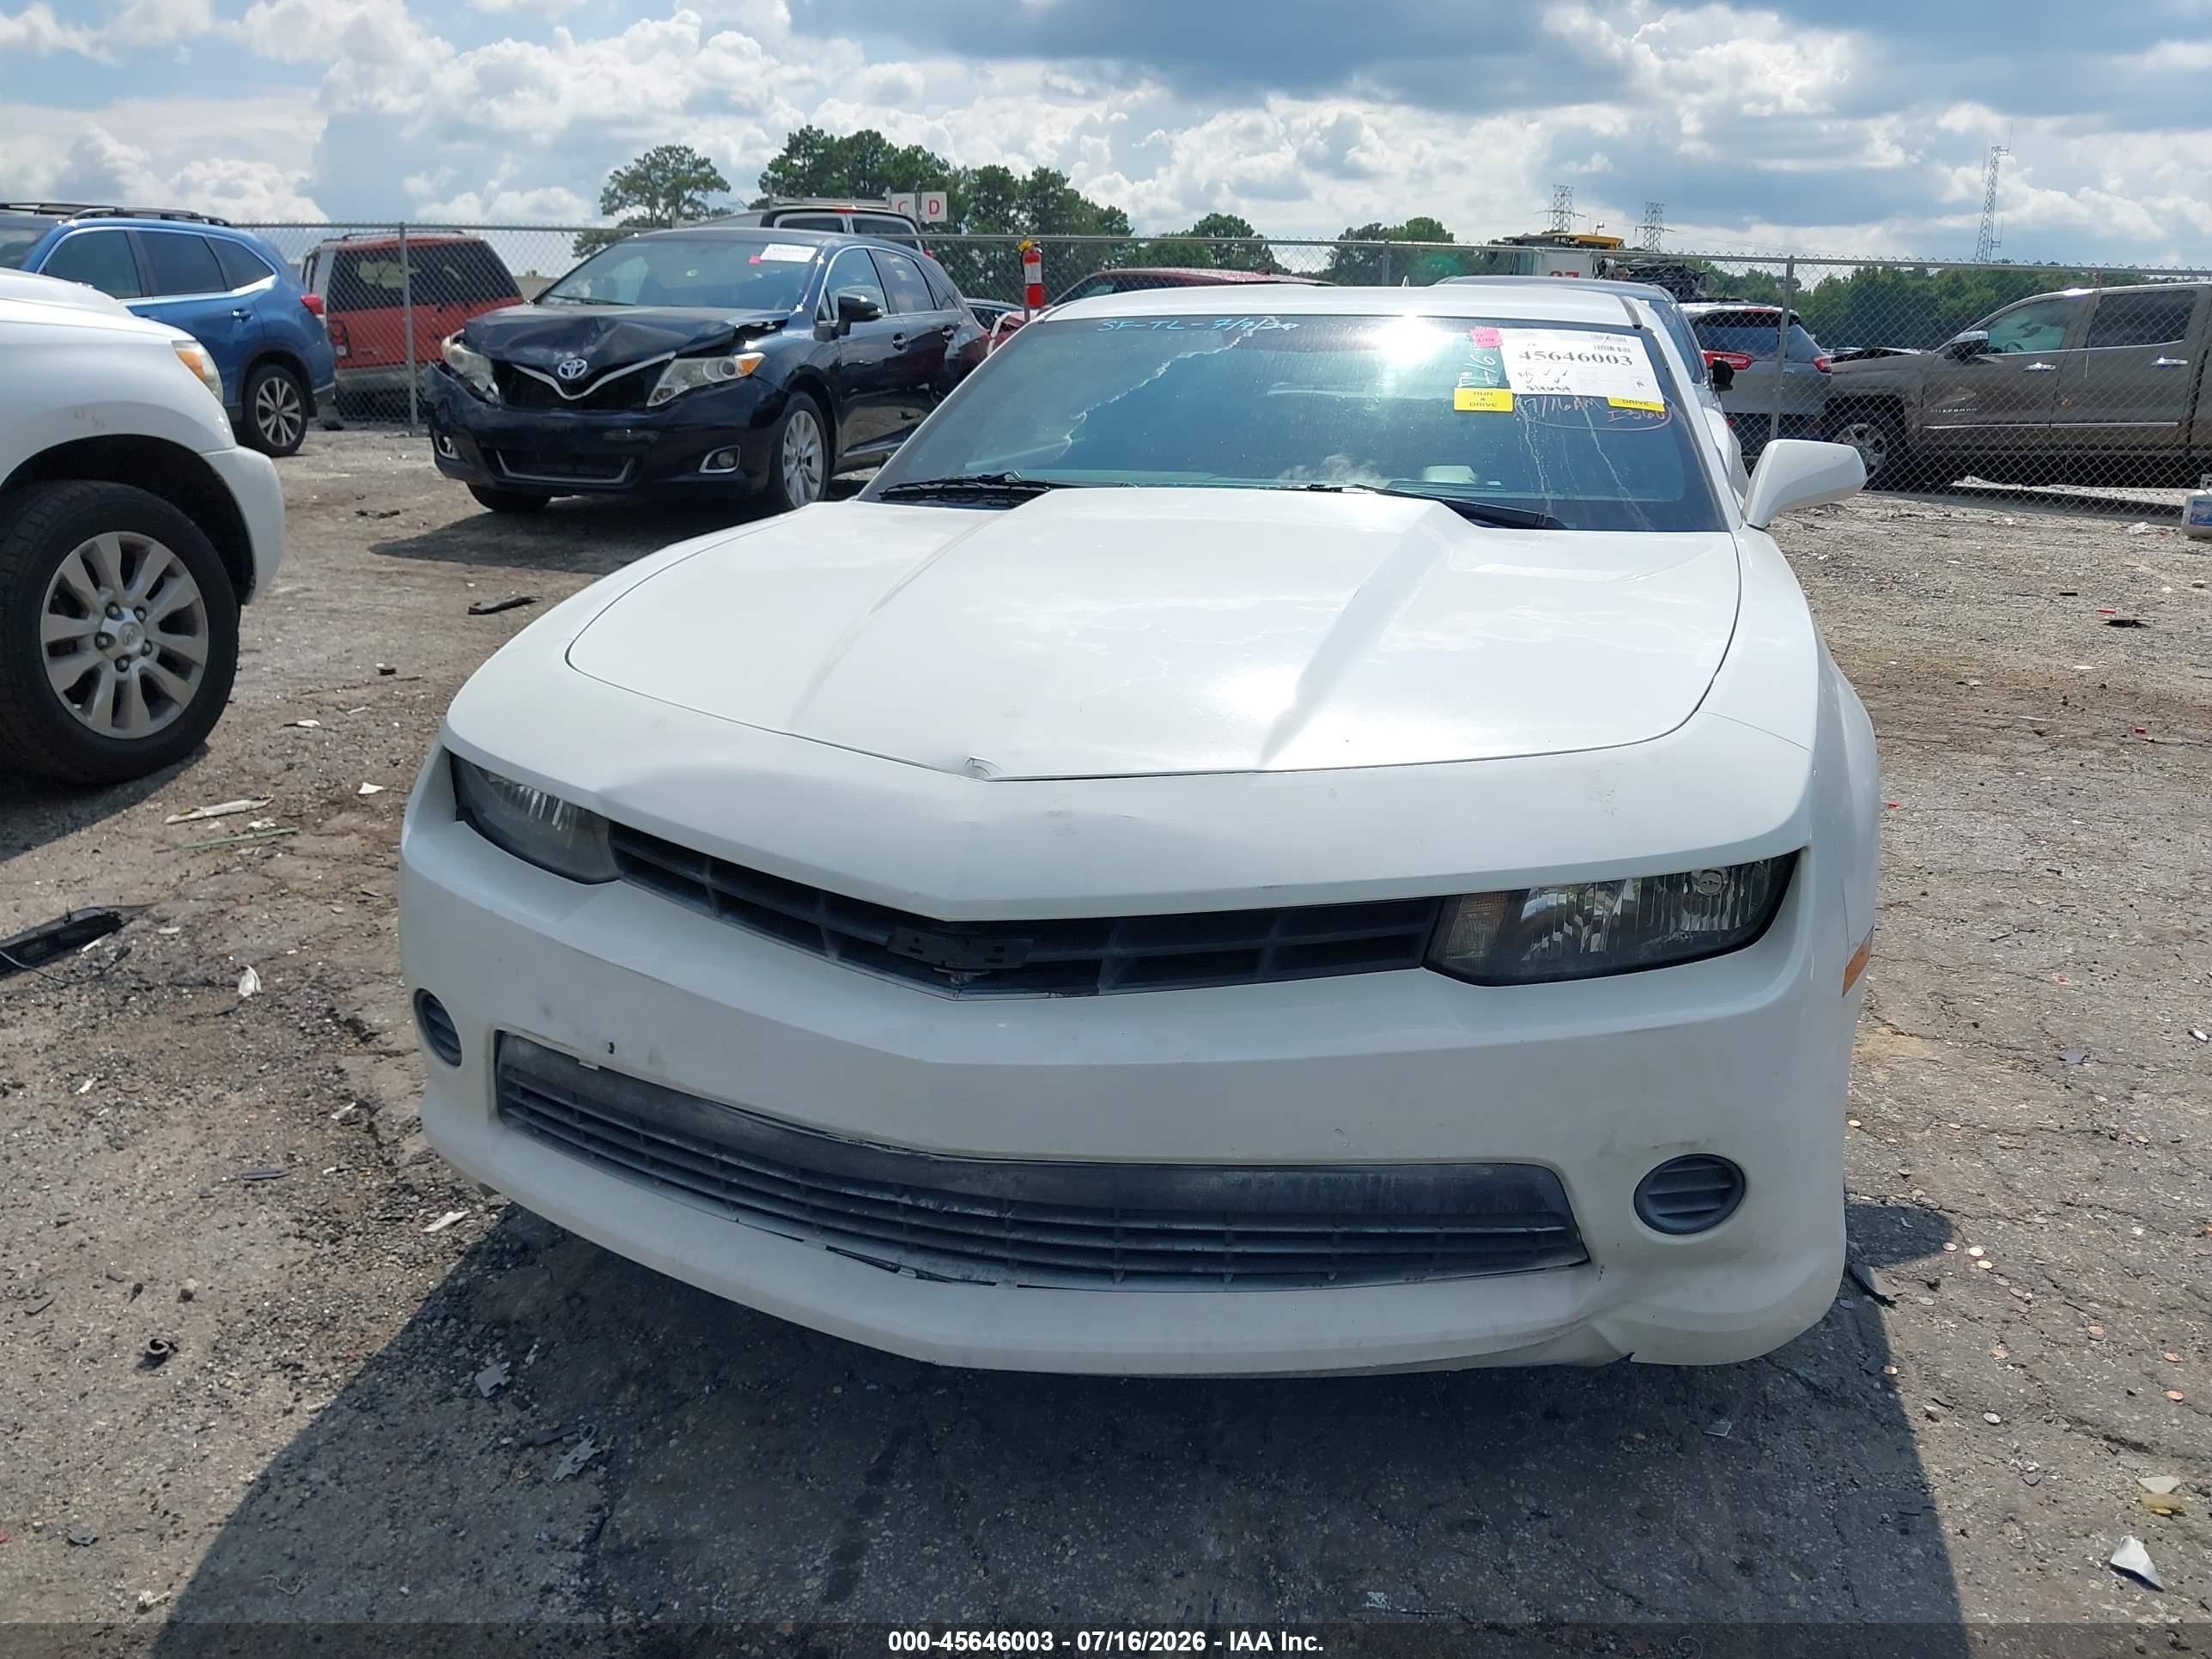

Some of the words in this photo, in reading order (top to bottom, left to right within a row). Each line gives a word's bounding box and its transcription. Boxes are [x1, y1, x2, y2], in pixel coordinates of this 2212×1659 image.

[897, 200, 908, 215] C
[928, 199, 941, 216] D
[1518, 349, 1634, 368] 45646003
